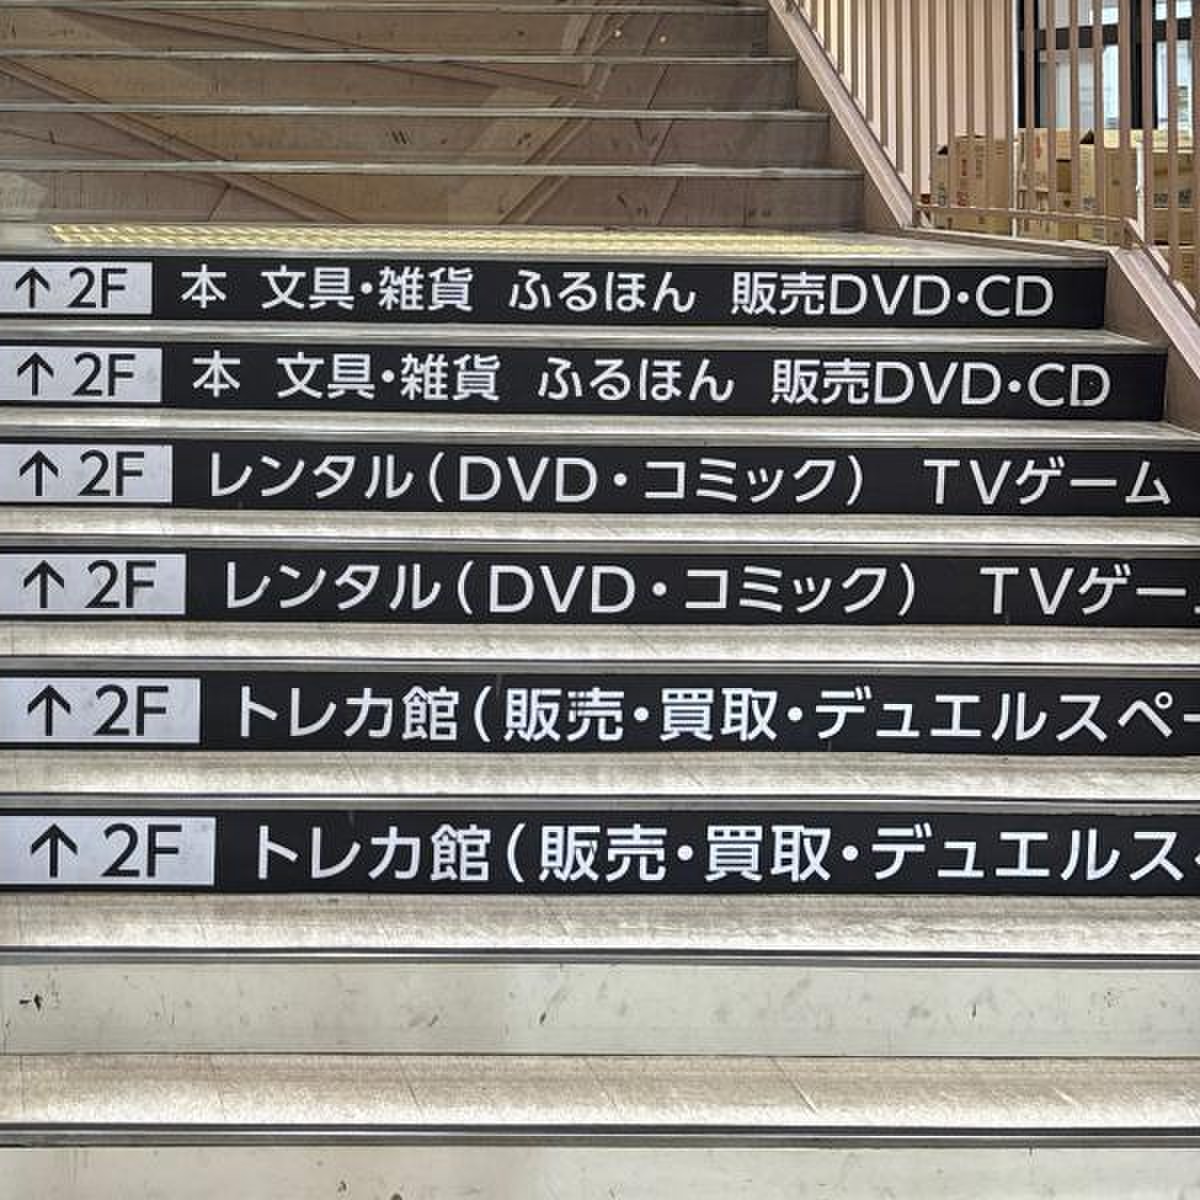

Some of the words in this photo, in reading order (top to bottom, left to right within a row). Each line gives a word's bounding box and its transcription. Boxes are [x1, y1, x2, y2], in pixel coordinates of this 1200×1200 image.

[68, 267, 128, 309] 2F
[181, 263, 227, 309] 本
[261, 265, 473, 312] 文具・雑貨
[508, 269, 696, 313] ふるほん
[730, 271, 1053, 317] 販売DVD・CD
[73, 351, 136, 396] 2F
[192, 350, 241, 397] 本
[276, 352, 501, 401] 文具・雑貨
[537, 357, 735, 402] ふるほん
[770, 358, 1111, 407] 販売DVD・CD
[77, 449, 145, 497] 2F
[923, 455, 1171, 505] TVゲーム
[85, 559, 157, 609] 2F
[980, 563, 1200, 615] TVゲー
[94, 684, 169, 737] 2F
[101, 823, 182, 878] 2F
[258, 822, 1200, 883] トレカ館(販売・買取・デュエルス
